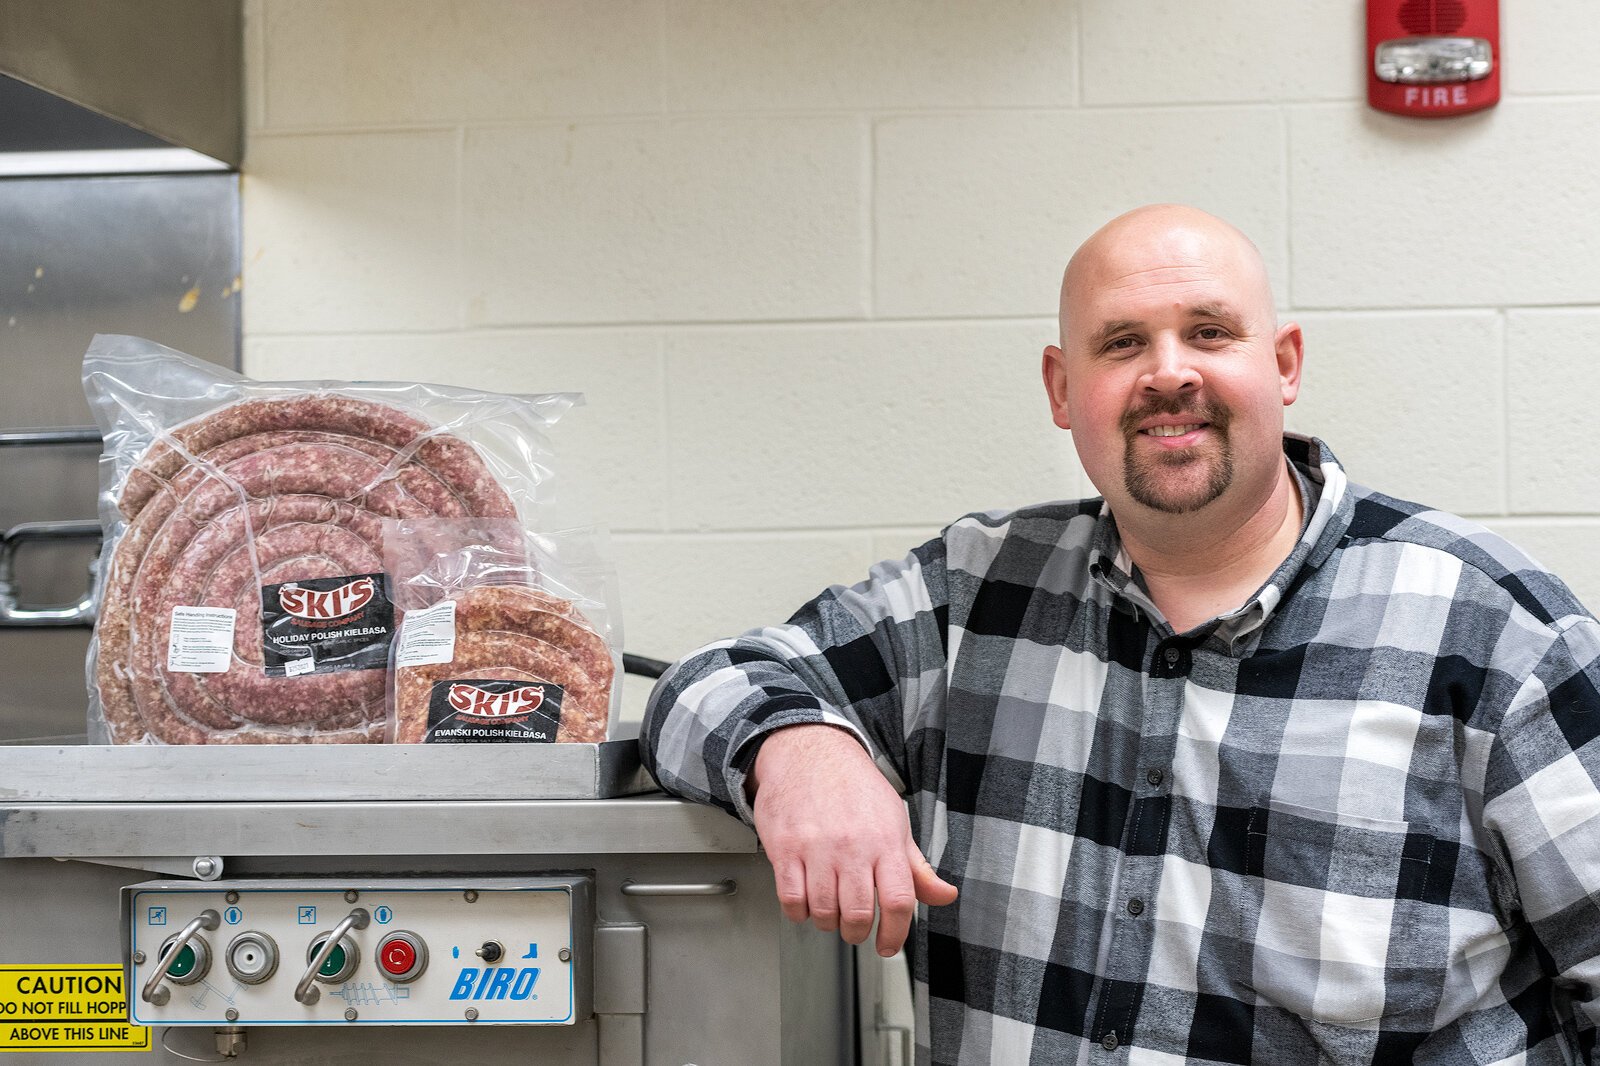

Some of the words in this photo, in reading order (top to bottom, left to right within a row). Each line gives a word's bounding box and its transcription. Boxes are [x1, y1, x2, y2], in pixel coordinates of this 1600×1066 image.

[1404, 86, 1468, 107] FIRE
[281, 580, 374, 618] SKI'S
[272, 633, 310, 645] HOLIDAY
[310, 630, 343, 641] POLISH
[343, 626, 387, 638] KIELBASA
[451, 684, 544, 716] SKI'S
[434, 728, 471, 738] EVANSKI
[472, 729, 504, 738] POLISH
[504, 729, 547, 740] KIELBASA
[16, 975, 122, 995] CAUTION
[449, 967, 542, 1001] BIRO
[22, 1001, 54, 1015] NOT
[58, 1001, 83, 1014] FILL
[9, 1027, 60, 1041] ABOVE
[64, 1027, 95, 1040] THIS
[99, 1027, 130, 1040] LINE
